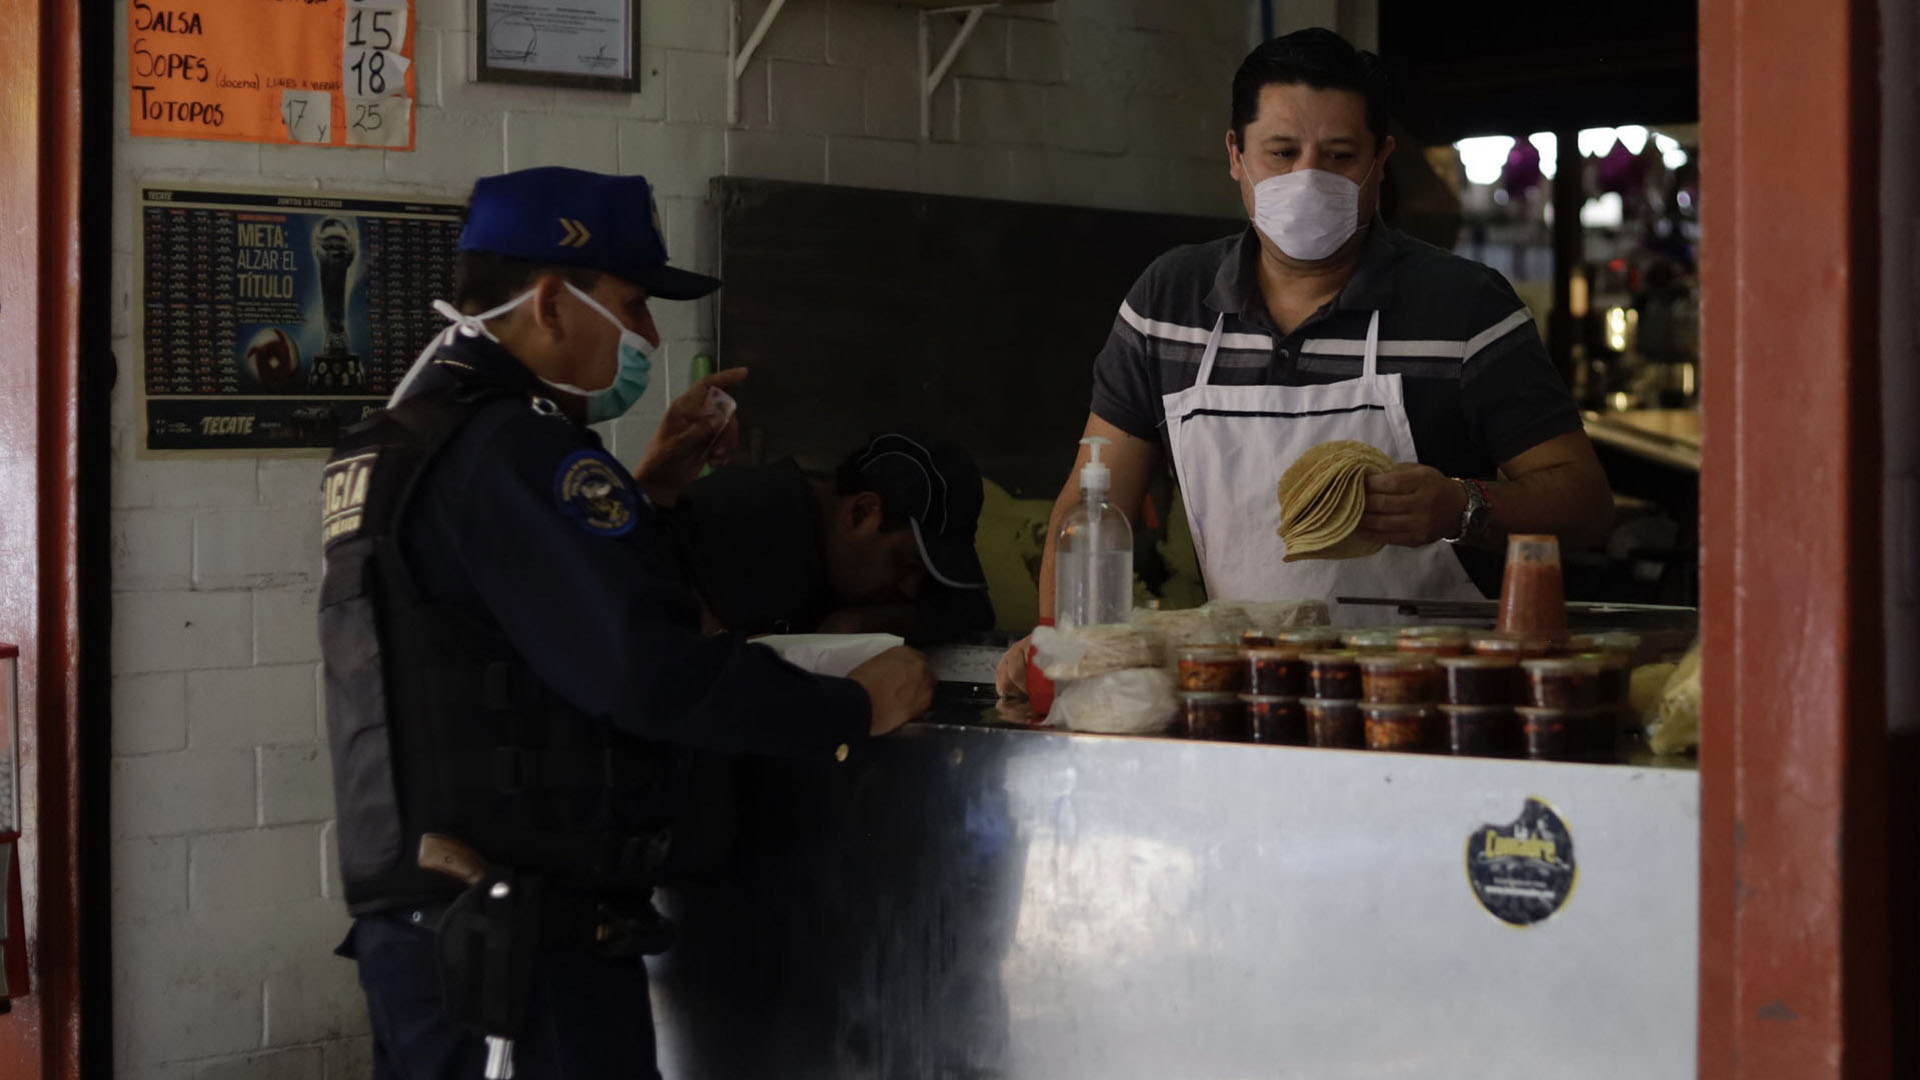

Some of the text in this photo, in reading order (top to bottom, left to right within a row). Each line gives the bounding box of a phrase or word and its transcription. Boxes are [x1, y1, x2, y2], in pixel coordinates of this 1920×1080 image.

[134, 0, 393, 50] SALSA 15
[134, 38, 209, 82] SOPES
[350, 52, 386, 95] 18
[132, 85, 225, 126] TOTOPOS
[286, 100, 308, 128] 17
[352, 104, 383, 132] 25
[237, 222, 289, 248] META:
[236, 249, 298, 271] ALZAR EL
[236, 272, 294, 299] TÍTULO
[200, 415, 256, 436] TECATE
